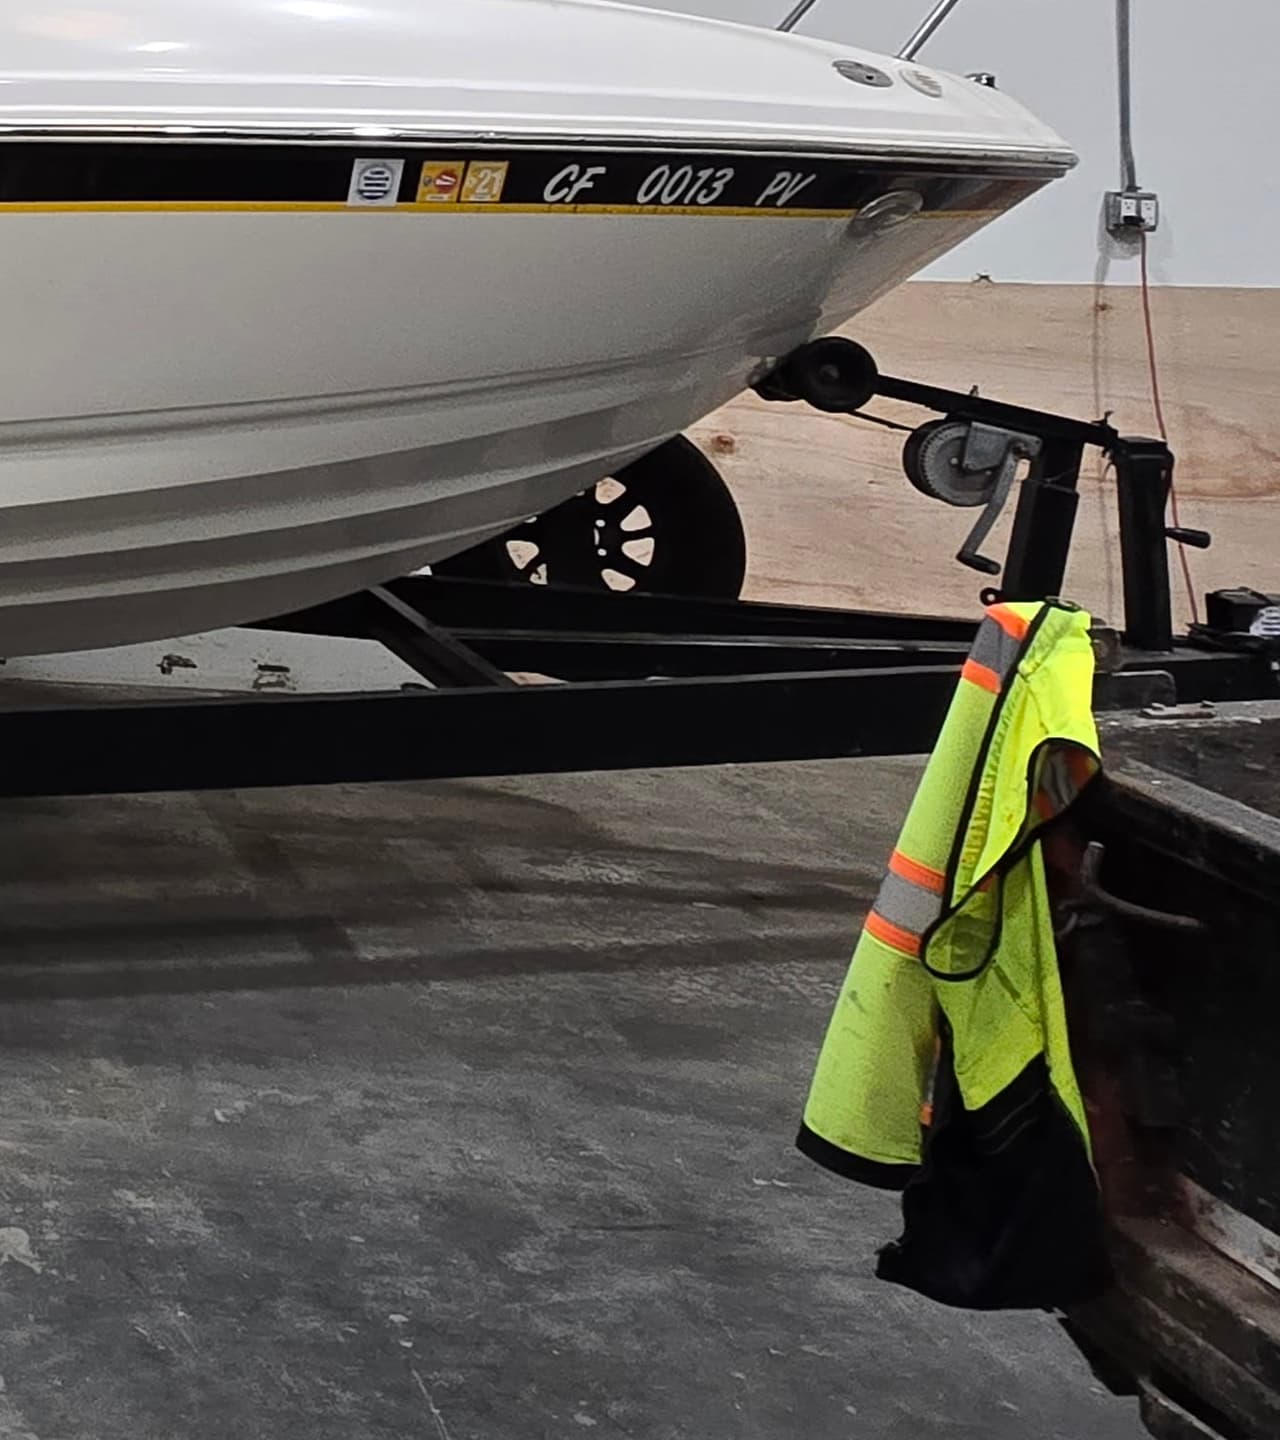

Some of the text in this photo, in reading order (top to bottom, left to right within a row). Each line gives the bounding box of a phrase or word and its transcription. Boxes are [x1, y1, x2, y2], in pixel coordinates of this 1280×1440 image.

[542, 163, 816, 207] CF 0013 PV
